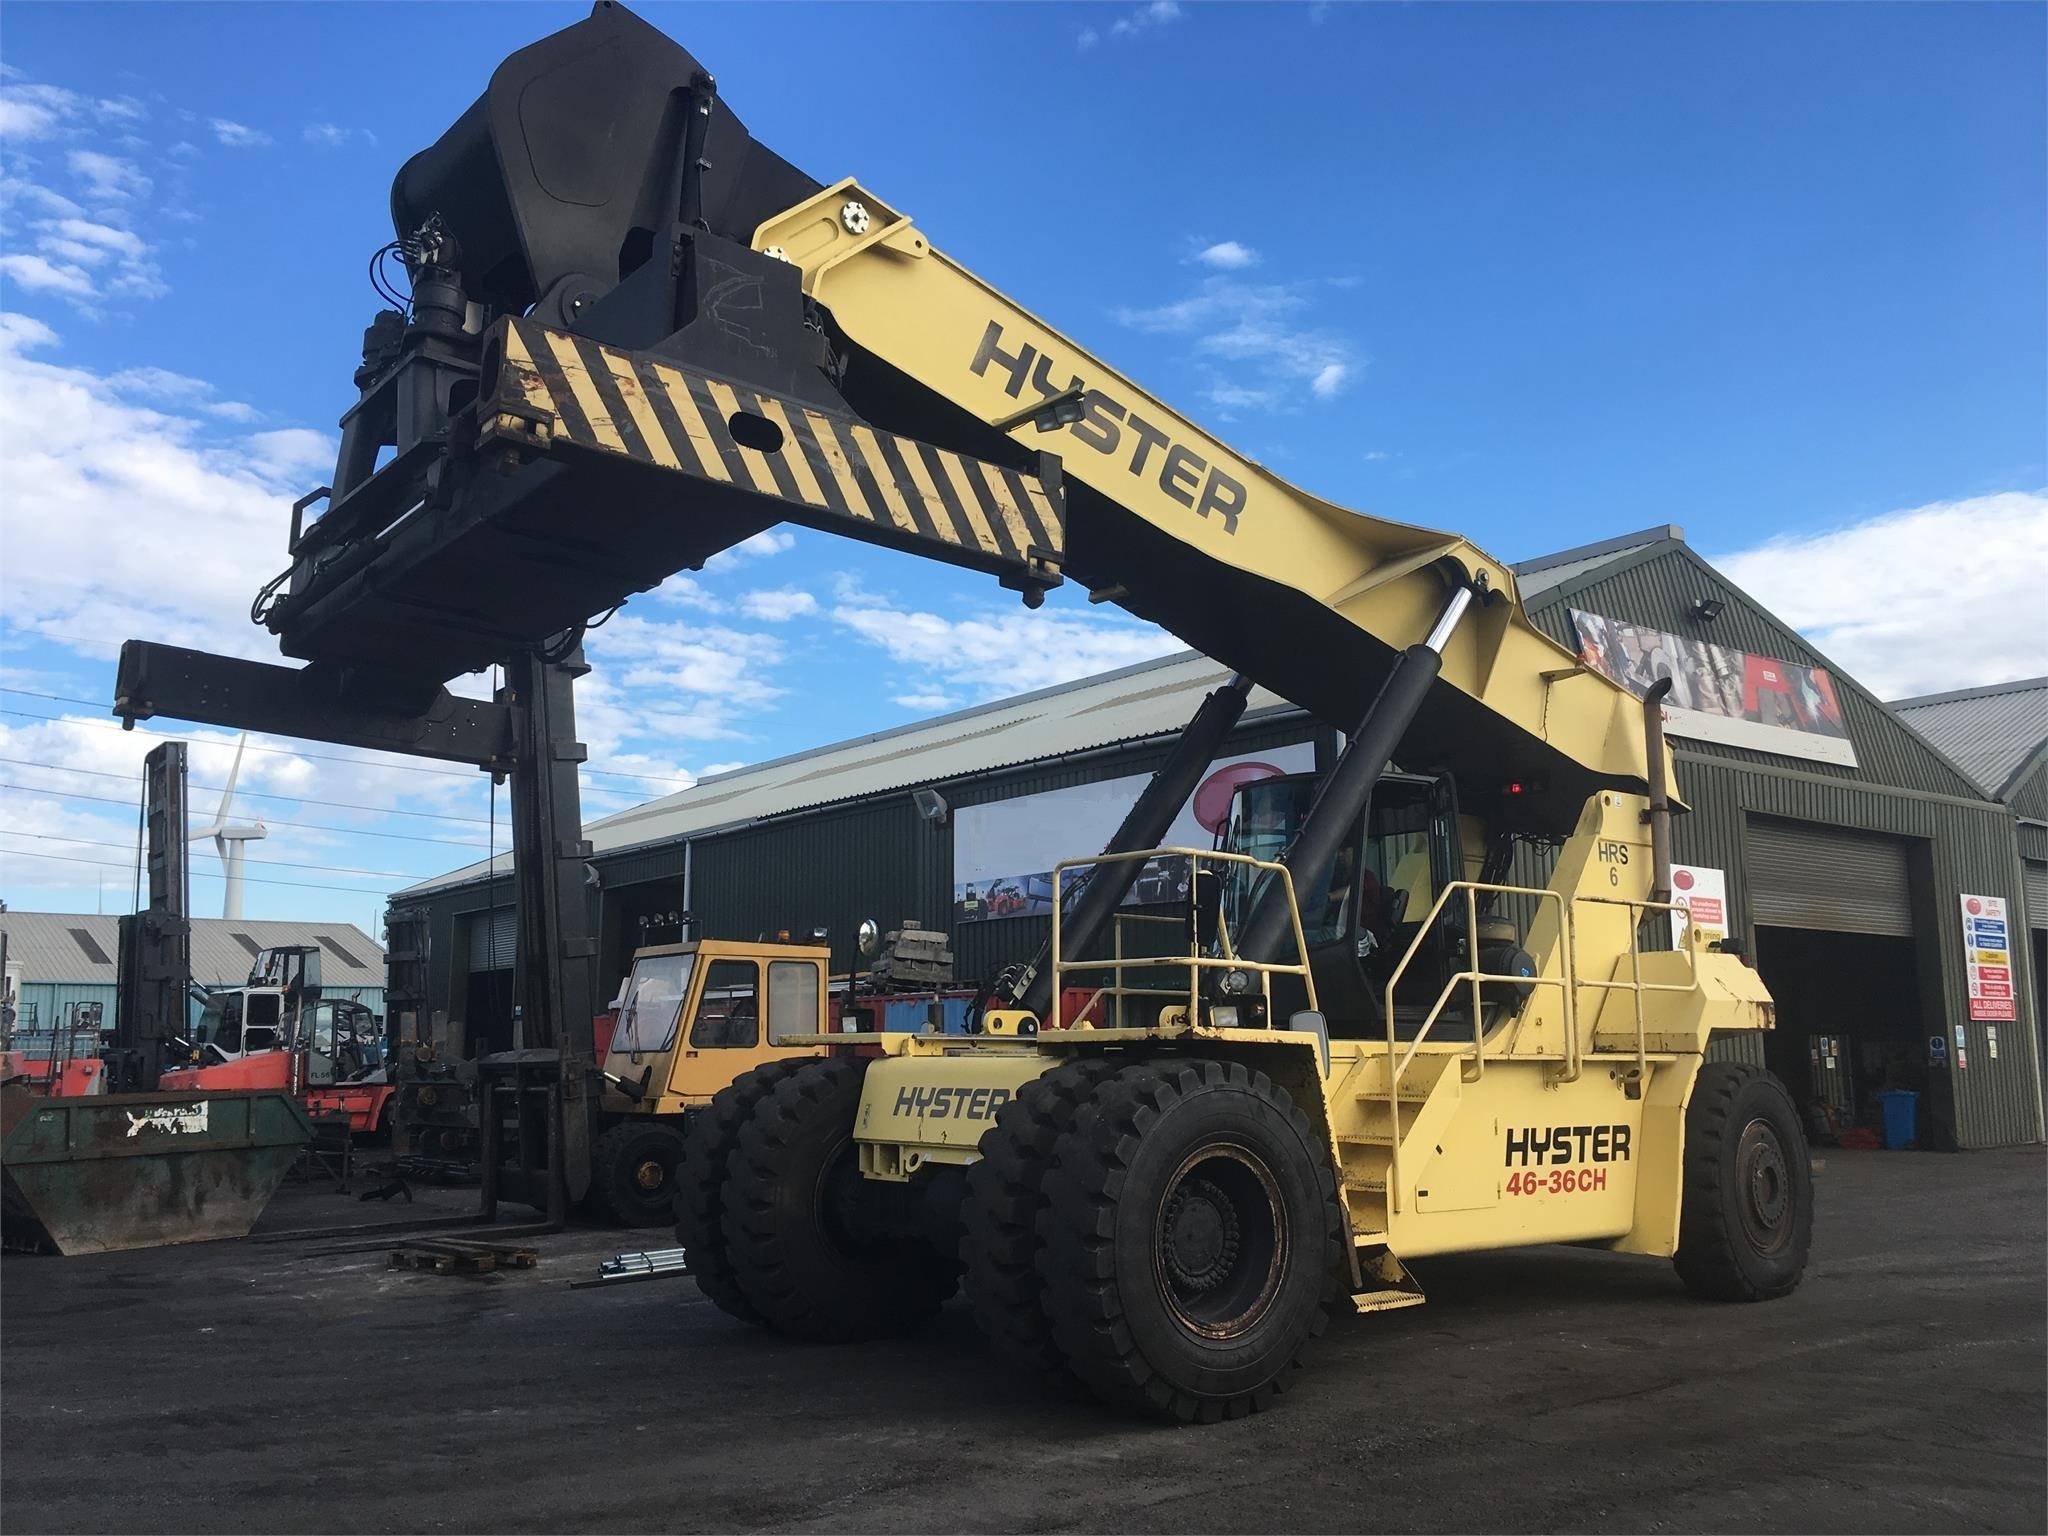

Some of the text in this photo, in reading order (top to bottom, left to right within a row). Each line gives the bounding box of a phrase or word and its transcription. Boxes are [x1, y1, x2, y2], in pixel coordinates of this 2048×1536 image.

[969, 320, 1247, 536] HYSTER
[1598, 842, 1629, 865] HRS
[1609, 866, 1618, 887] 6
[1973, 1000, 2012, 1010] ALL DELIVERIES
[893, 1087, 1010, 1120] HYSTER
[1505, 1125, 1631, 1167] HYSTER
[1506, 1168, 1606, 1196] 46-36CH
